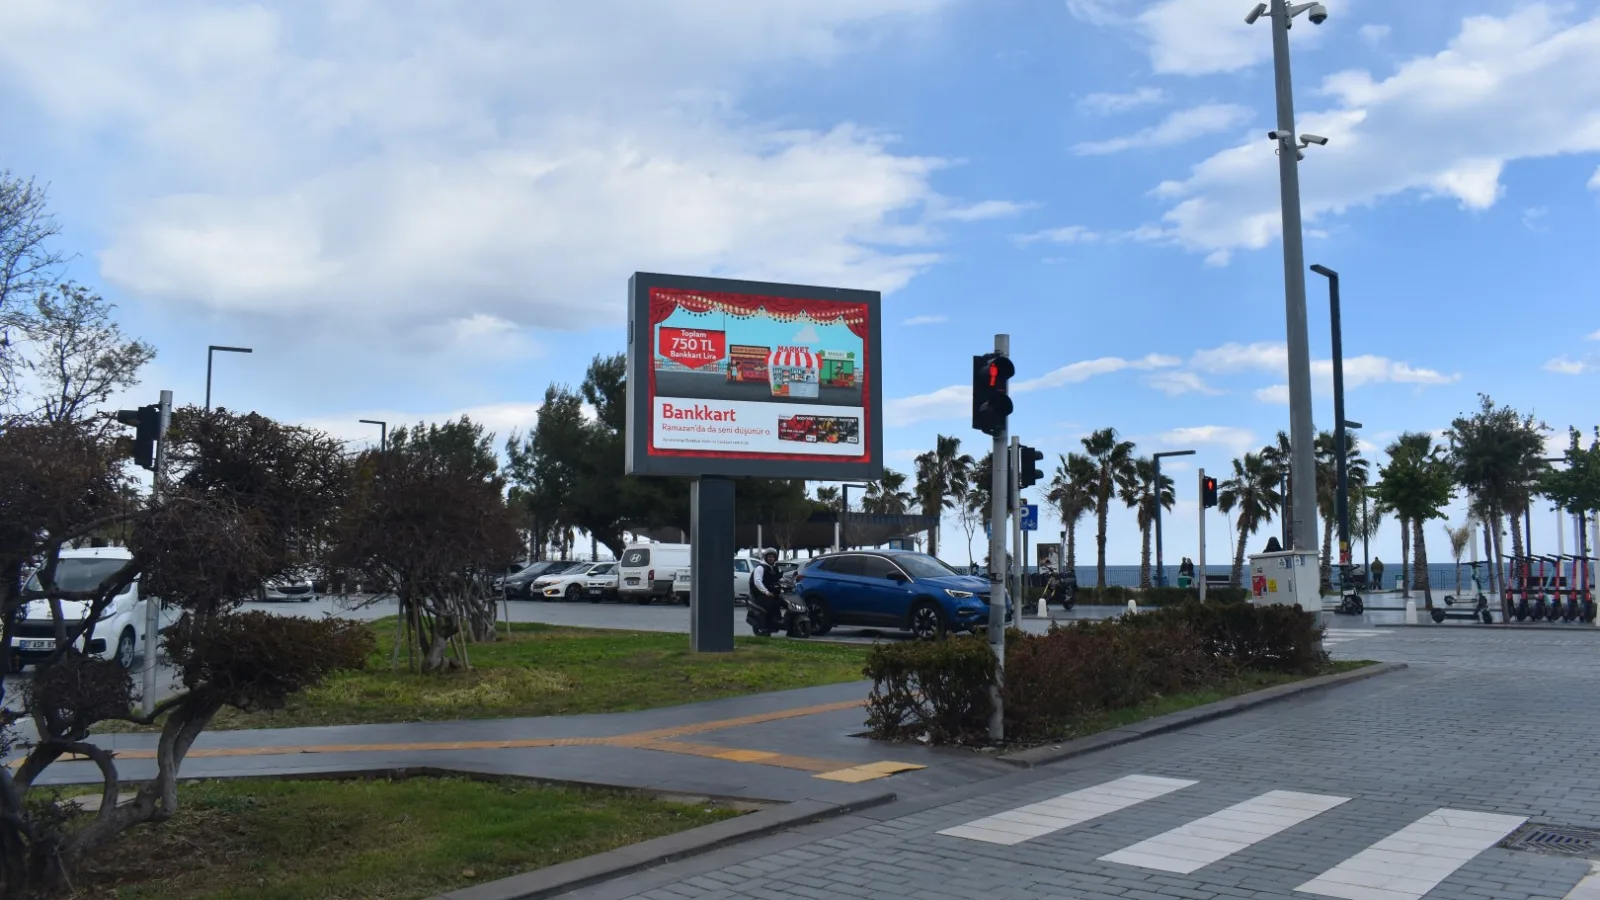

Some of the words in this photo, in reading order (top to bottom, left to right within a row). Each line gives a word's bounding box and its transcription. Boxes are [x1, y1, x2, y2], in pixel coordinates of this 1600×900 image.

[681, 329, 707, 339] Toplam
[671, 337, 696, 350] 750
[701, 339, 716, 352] TL
[777, 345, 810, 354] MARKET
[670, 351, 701, 360] Bankkart
[703, 353, 717, 361] Lira
[662, 403, 736, 422] Bankkart
[662, 423, 706, 433] Ramazan'da
[707, 425, 717, 433] da
[718, 425, 733, 434] seni
[734, 426, 764, 436] düşünür
